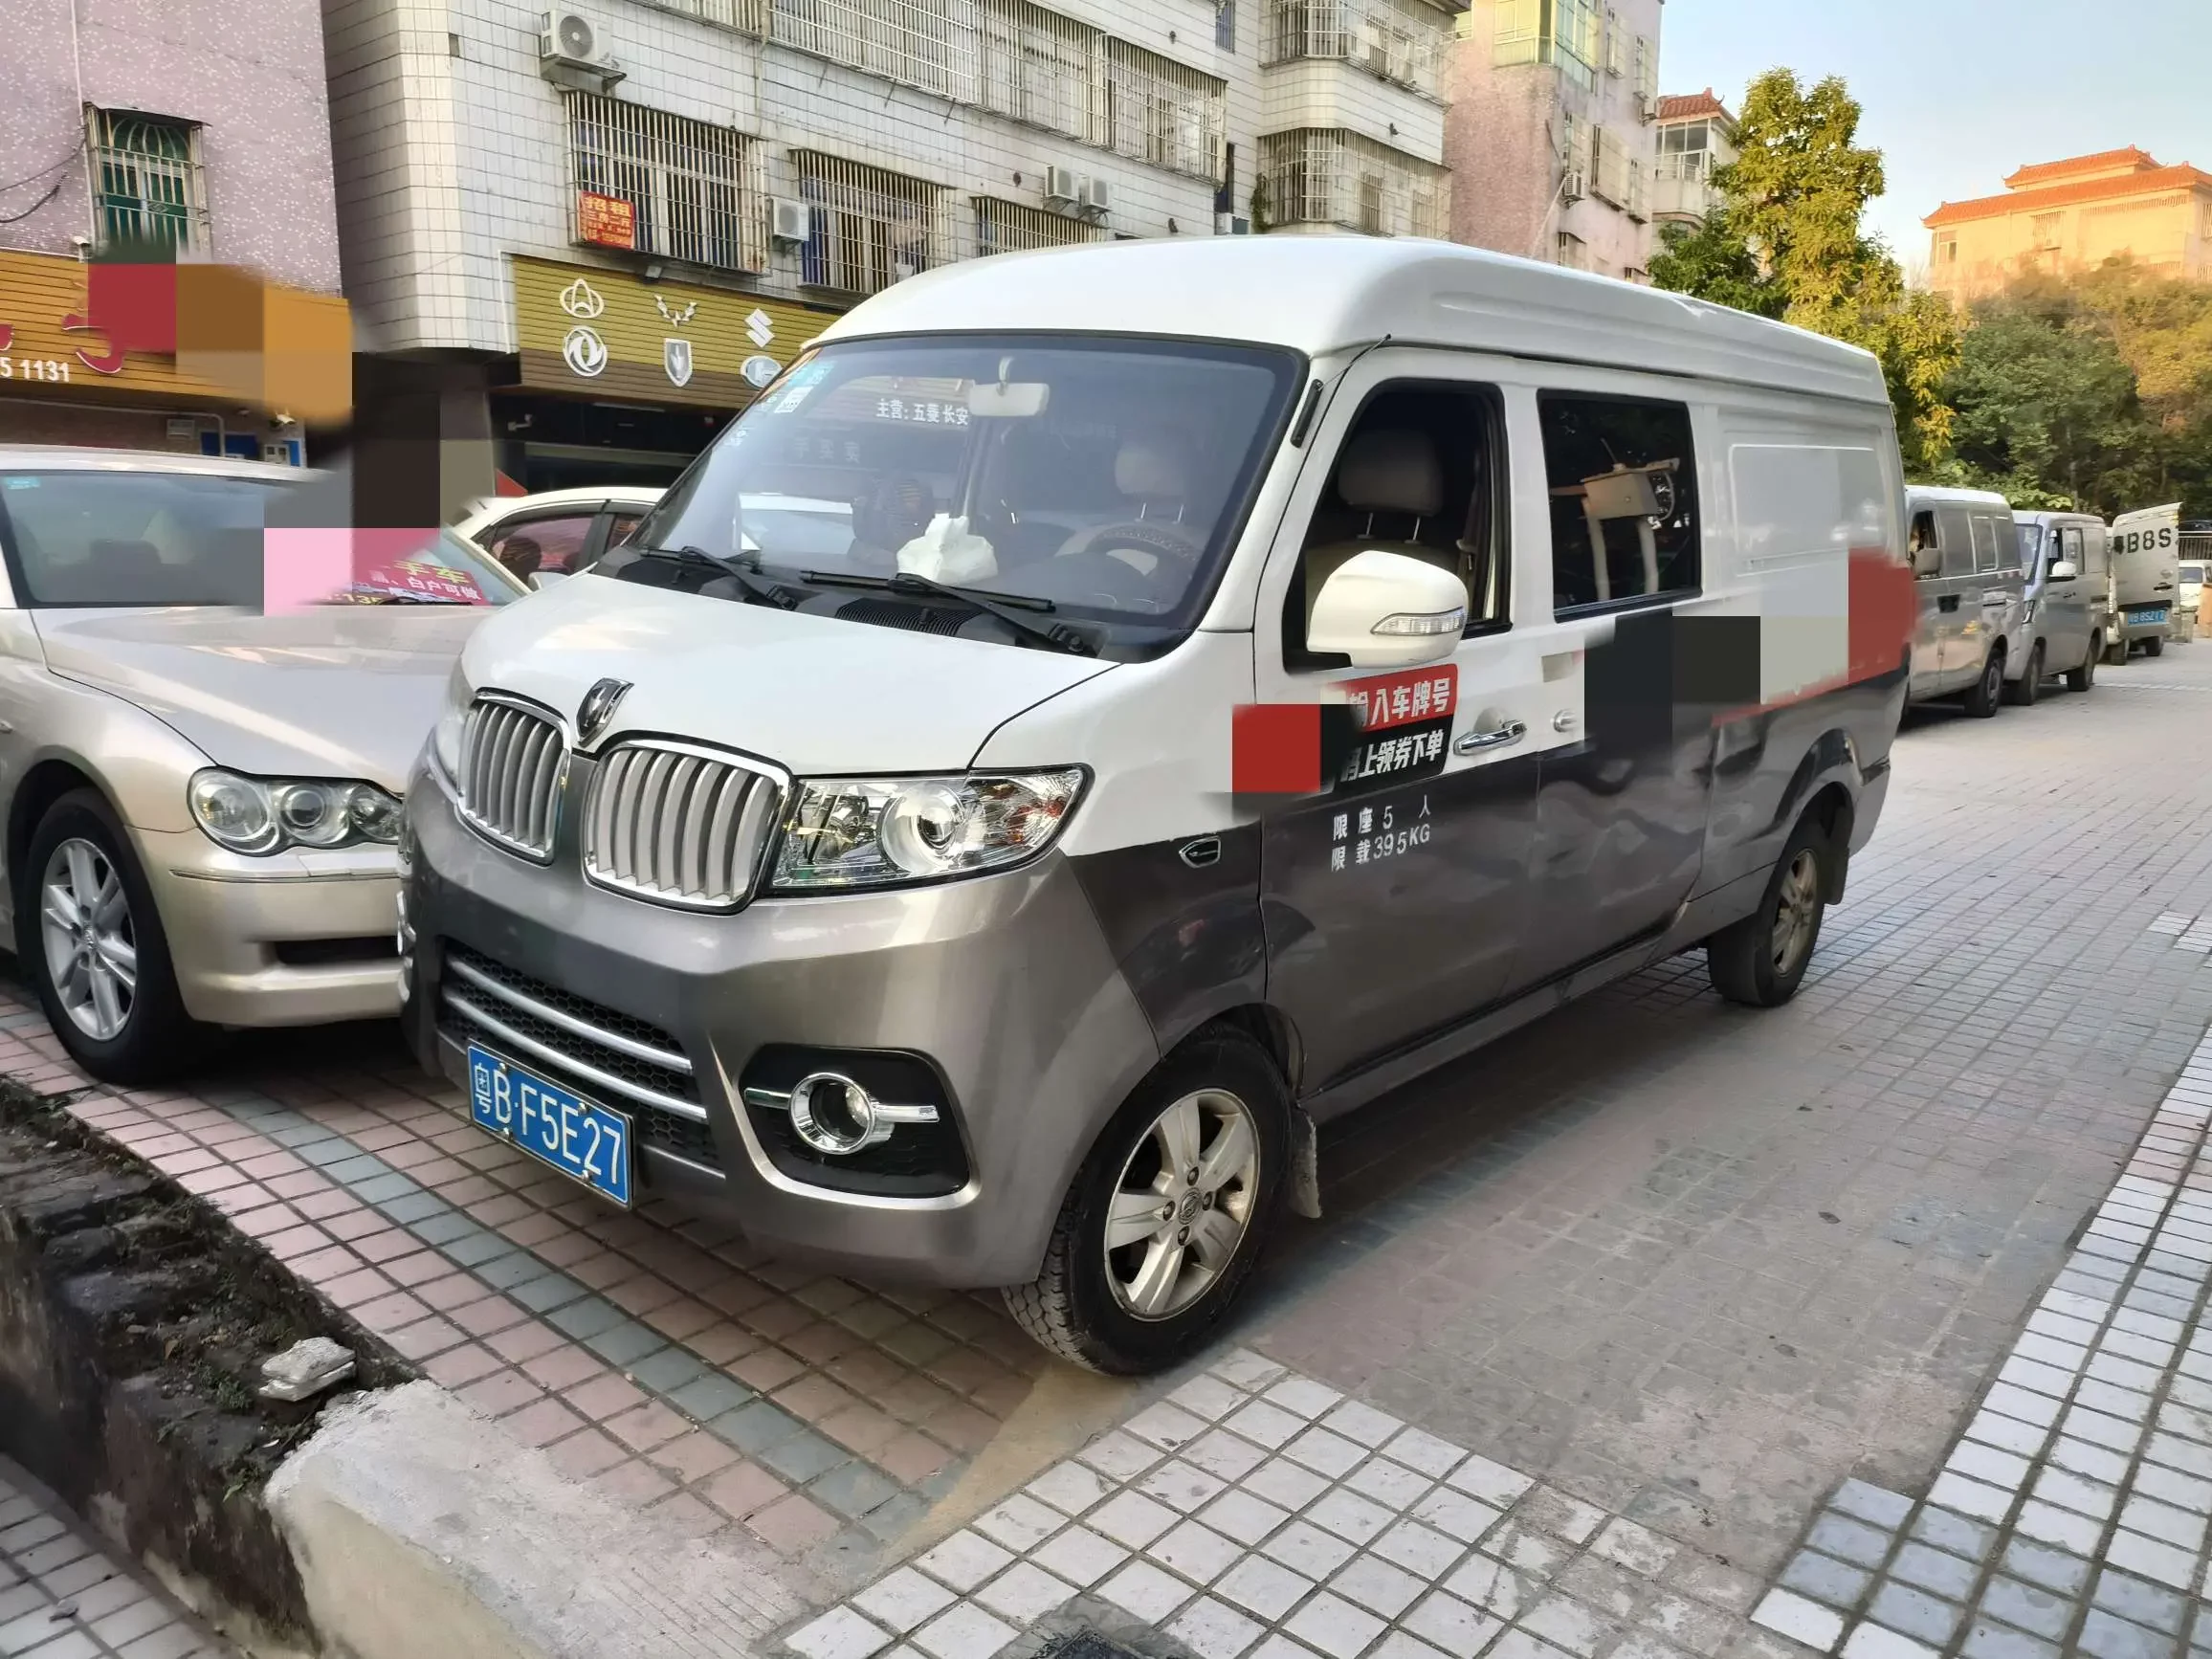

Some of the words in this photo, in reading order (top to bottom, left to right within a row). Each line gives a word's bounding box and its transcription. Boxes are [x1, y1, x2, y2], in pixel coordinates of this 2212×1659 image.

[585, 195, 631, 218] 招租
[19, 359, 70, 383] 1131
[380, 560, 470, 585] 手车
